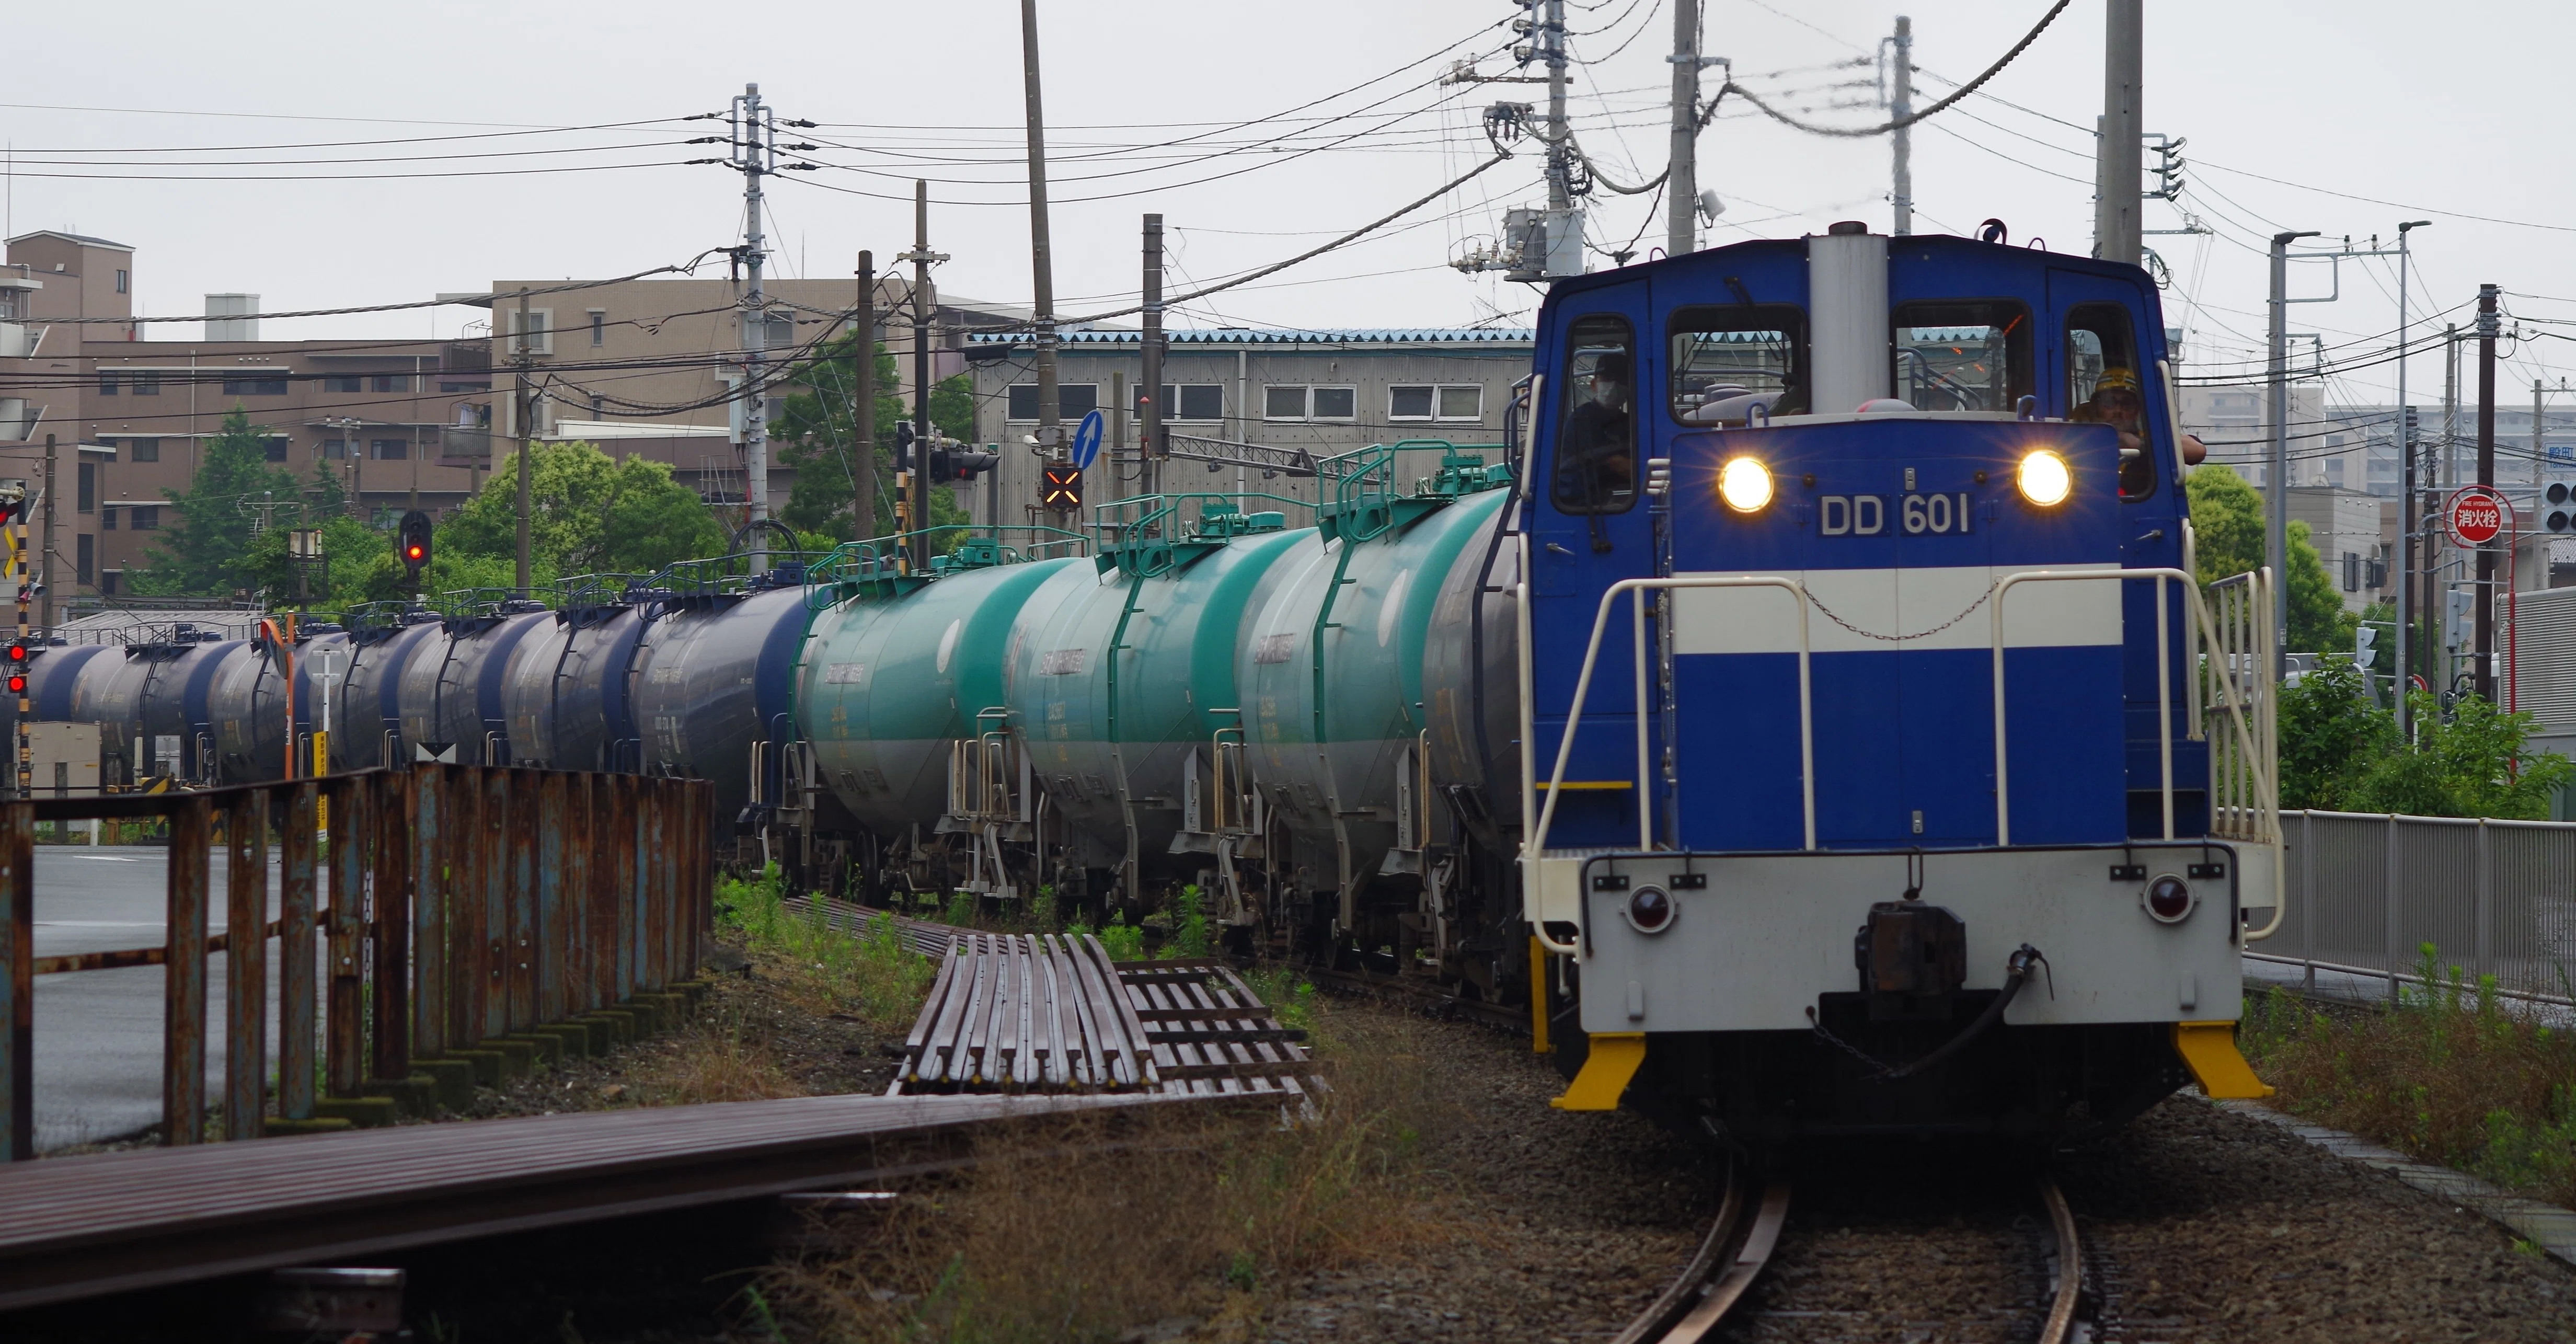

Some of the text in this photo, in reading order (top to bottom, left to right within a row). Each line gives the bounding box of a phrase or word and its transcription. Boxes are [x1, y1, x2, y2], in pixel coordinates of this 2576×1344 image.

[1822, 493, 1968, 535] DD 601
[2458, 509, 2498, 527] 消火栓
